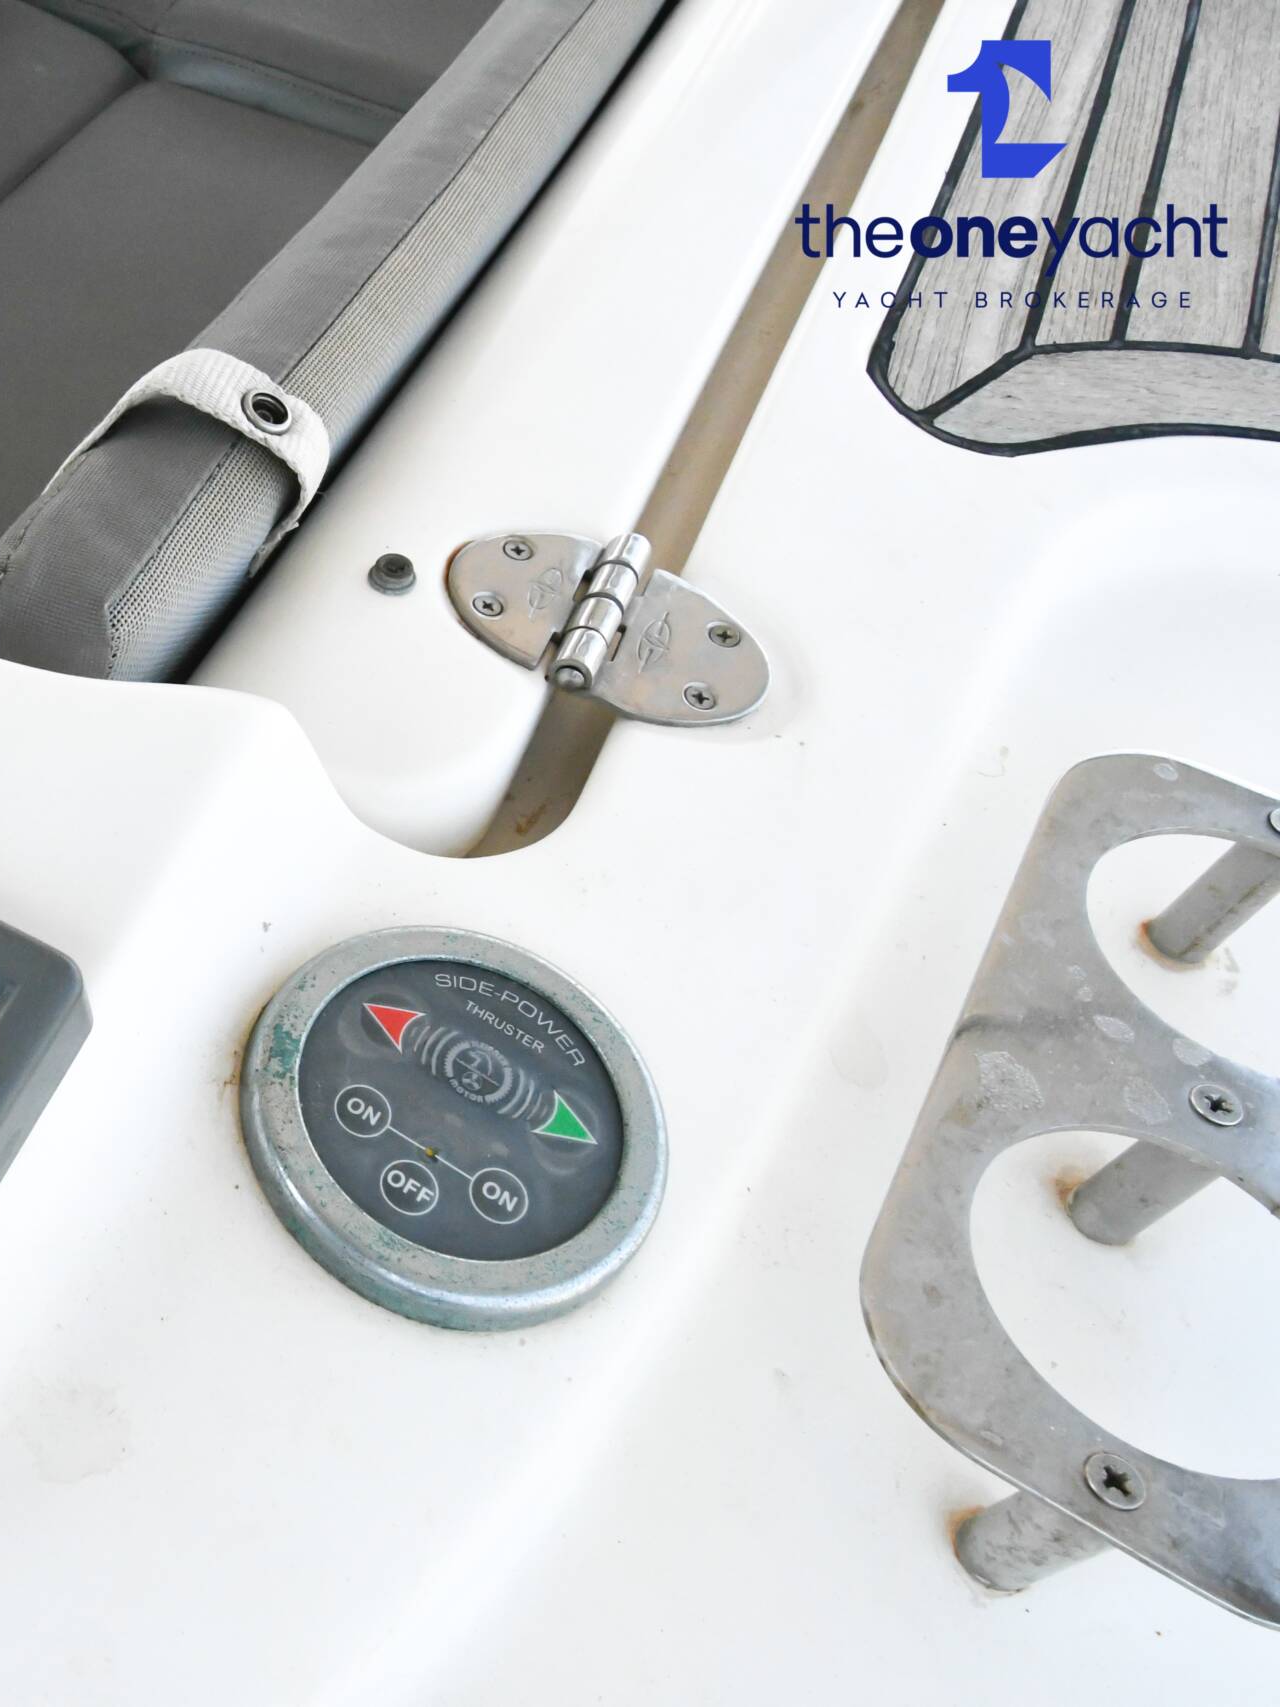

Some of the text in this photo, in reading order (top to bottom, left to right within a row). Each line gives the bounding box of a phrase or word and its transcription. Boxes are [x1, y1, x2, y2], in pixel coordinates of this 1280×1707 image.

[434, 973, 586, 1067] SIDE-POWER
[465, 999, 545, 1054] THRUSTER
[347, 1097, 382, 1126] ON
[387, 1169, 435, 1203] OFF
[482, 1181, 518, 1212] ON
